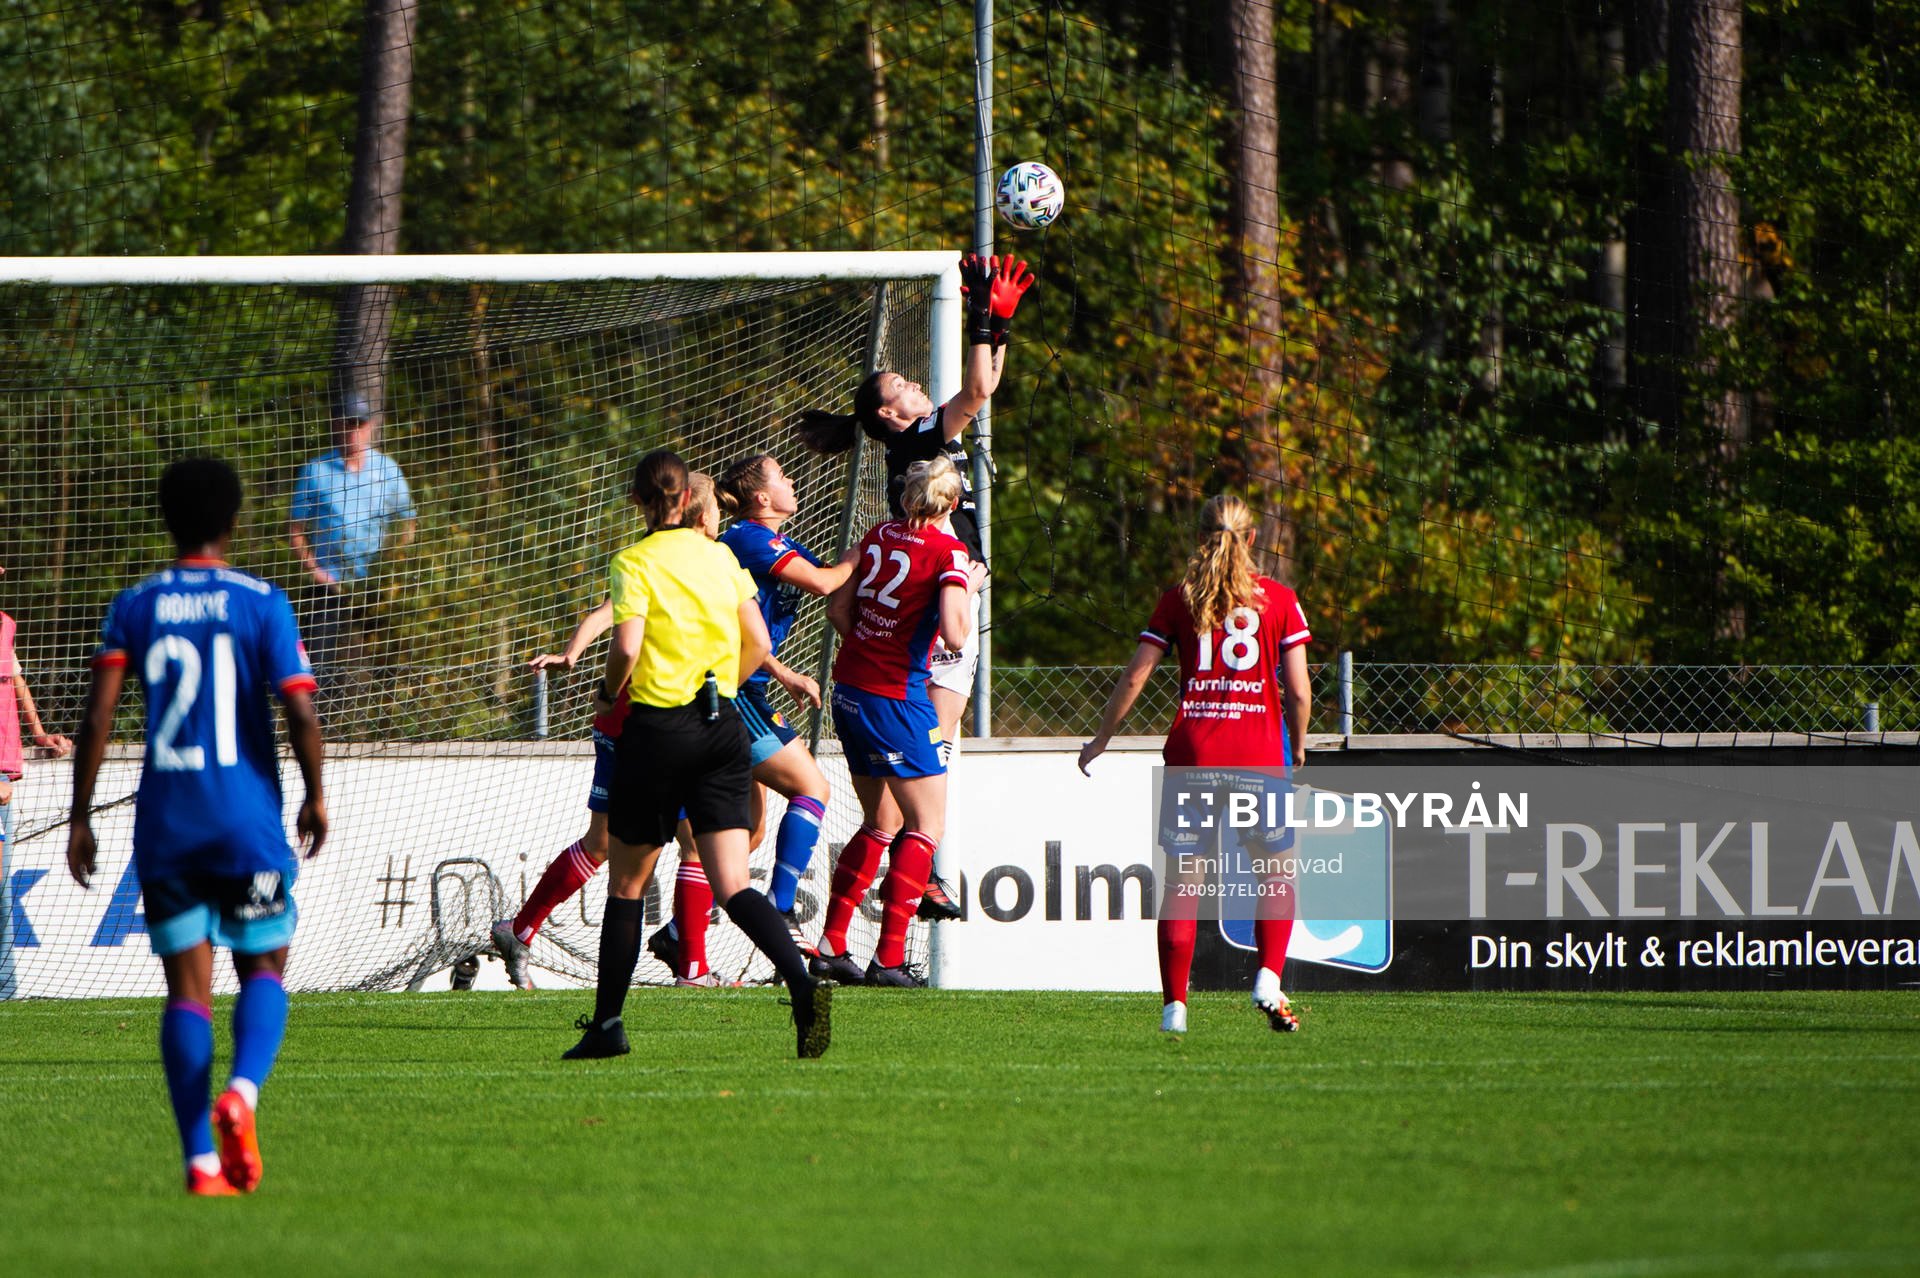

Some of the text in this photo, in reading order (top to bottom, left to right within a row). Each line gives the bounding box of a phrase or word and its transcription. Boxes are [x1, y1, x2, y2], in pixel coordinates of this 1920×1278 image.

[856, 544, 911, 609] 22
[1197, 606, 1260, 671] 18
[146, 634, 237, 770] 21
[1182, 700, 1266, 713] Motorcentrum
[1188, 676, 1264, 693] furninova
[1471, 930, 1920, 974] Din skylt & reklamlevera
